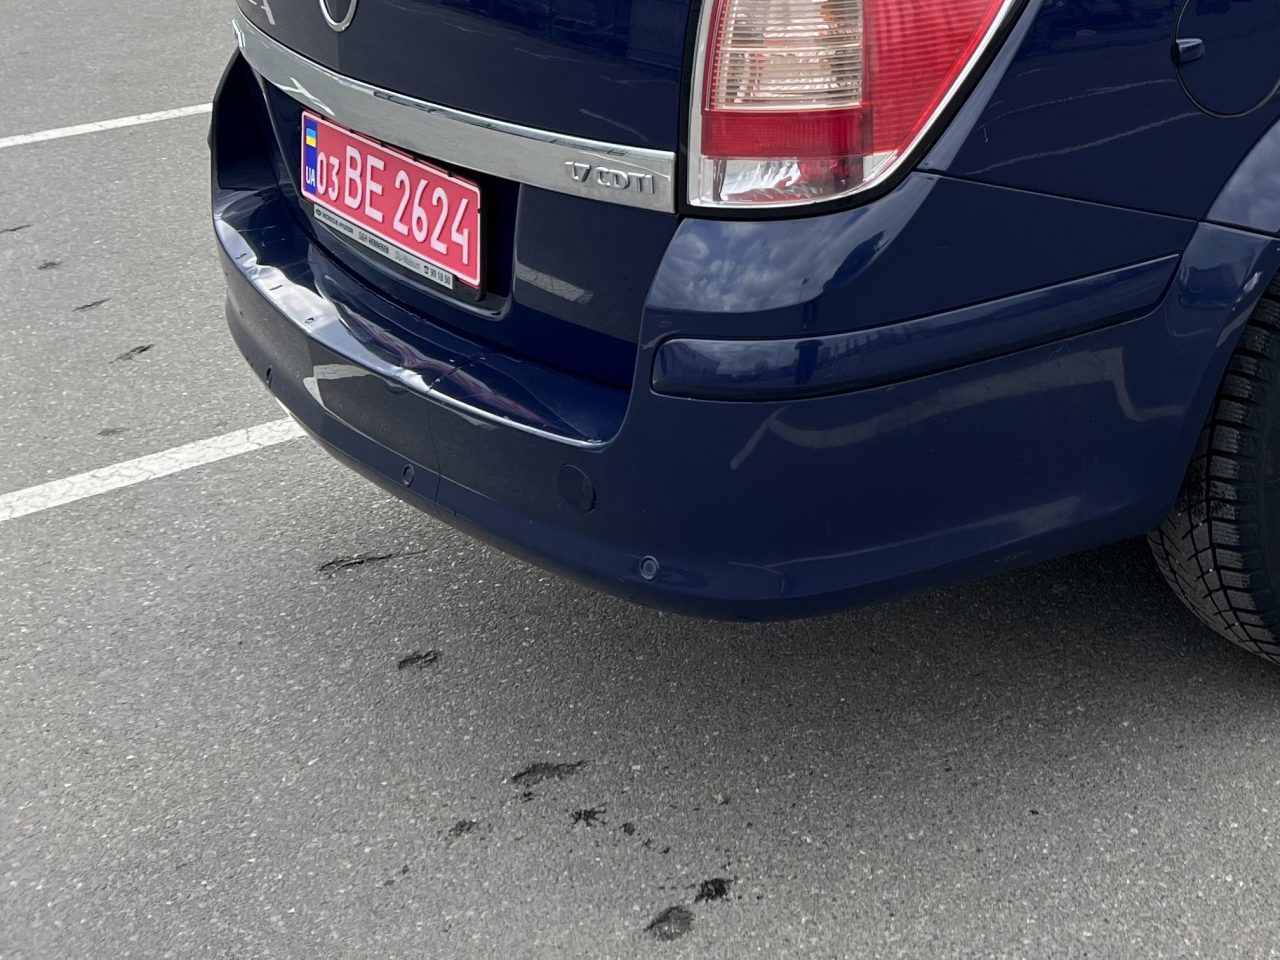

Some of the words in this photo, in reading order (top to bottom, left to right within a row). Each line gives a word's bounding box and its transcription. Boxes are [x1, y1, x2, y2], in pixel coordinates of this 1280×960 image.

[305, 165, 316, 188] UA
[593, 166, 655, 195] CDTI
[316, 151, 340, 202] 03
[343, 145, 385, 224] BE
[392, 169, 469, 266] 2624
